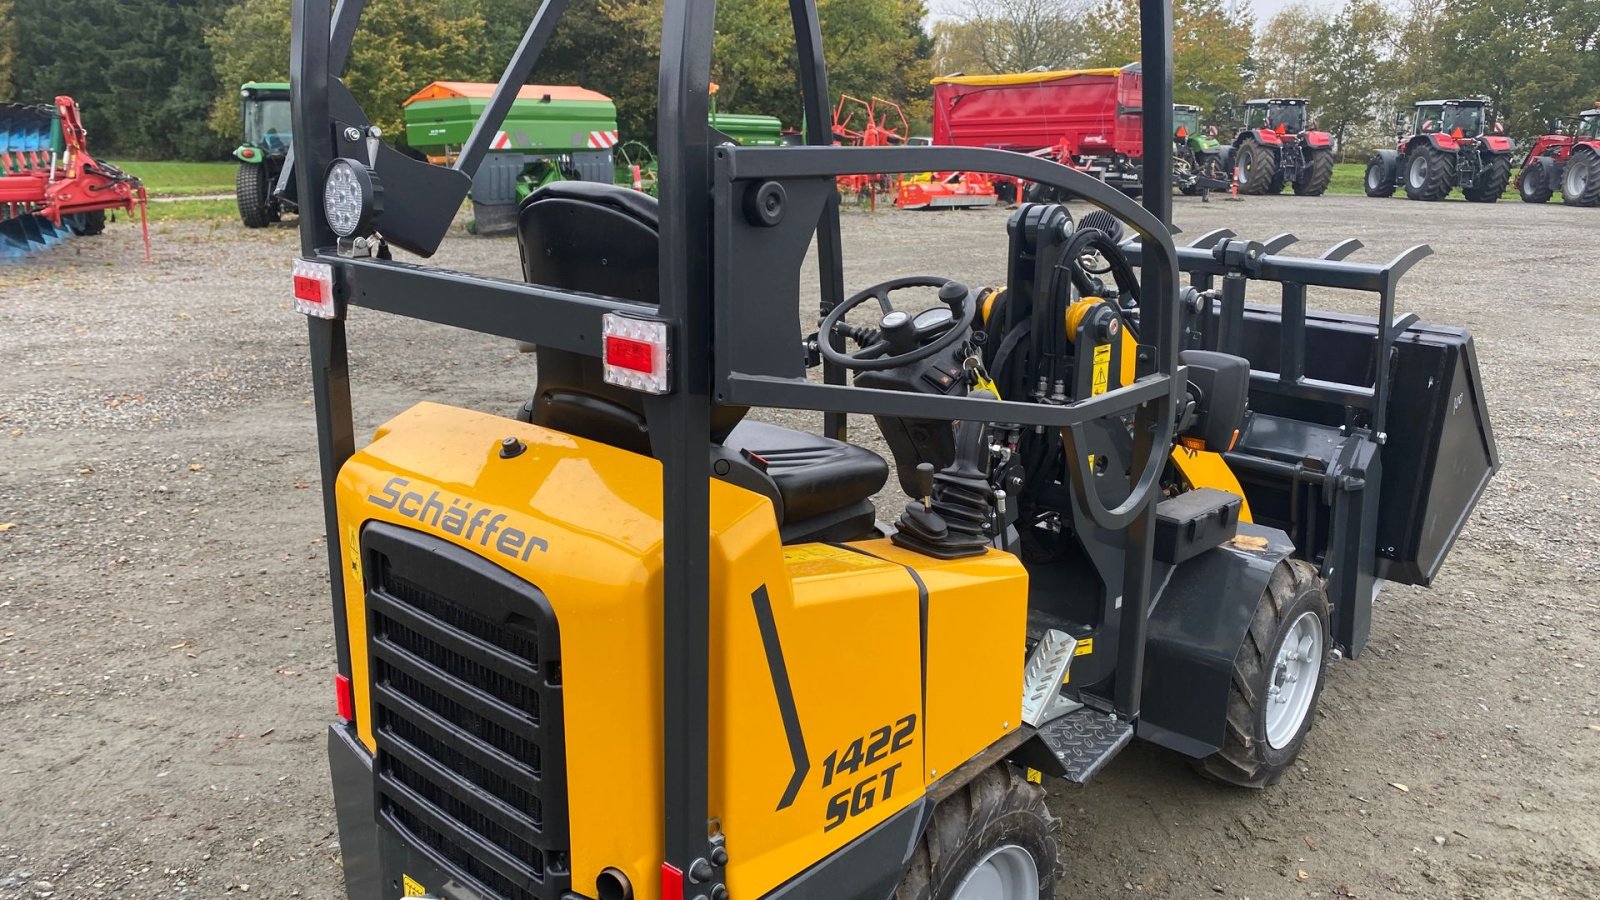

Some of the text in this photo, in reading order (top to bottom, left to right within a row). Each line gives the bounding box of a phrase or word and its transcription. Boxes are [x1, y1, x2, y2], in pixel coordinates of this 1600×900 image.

[368, 477, 549, 562] Schäffer
[822, 713, 917, 789] 1422
[823, 762, 902, 833] SGT
